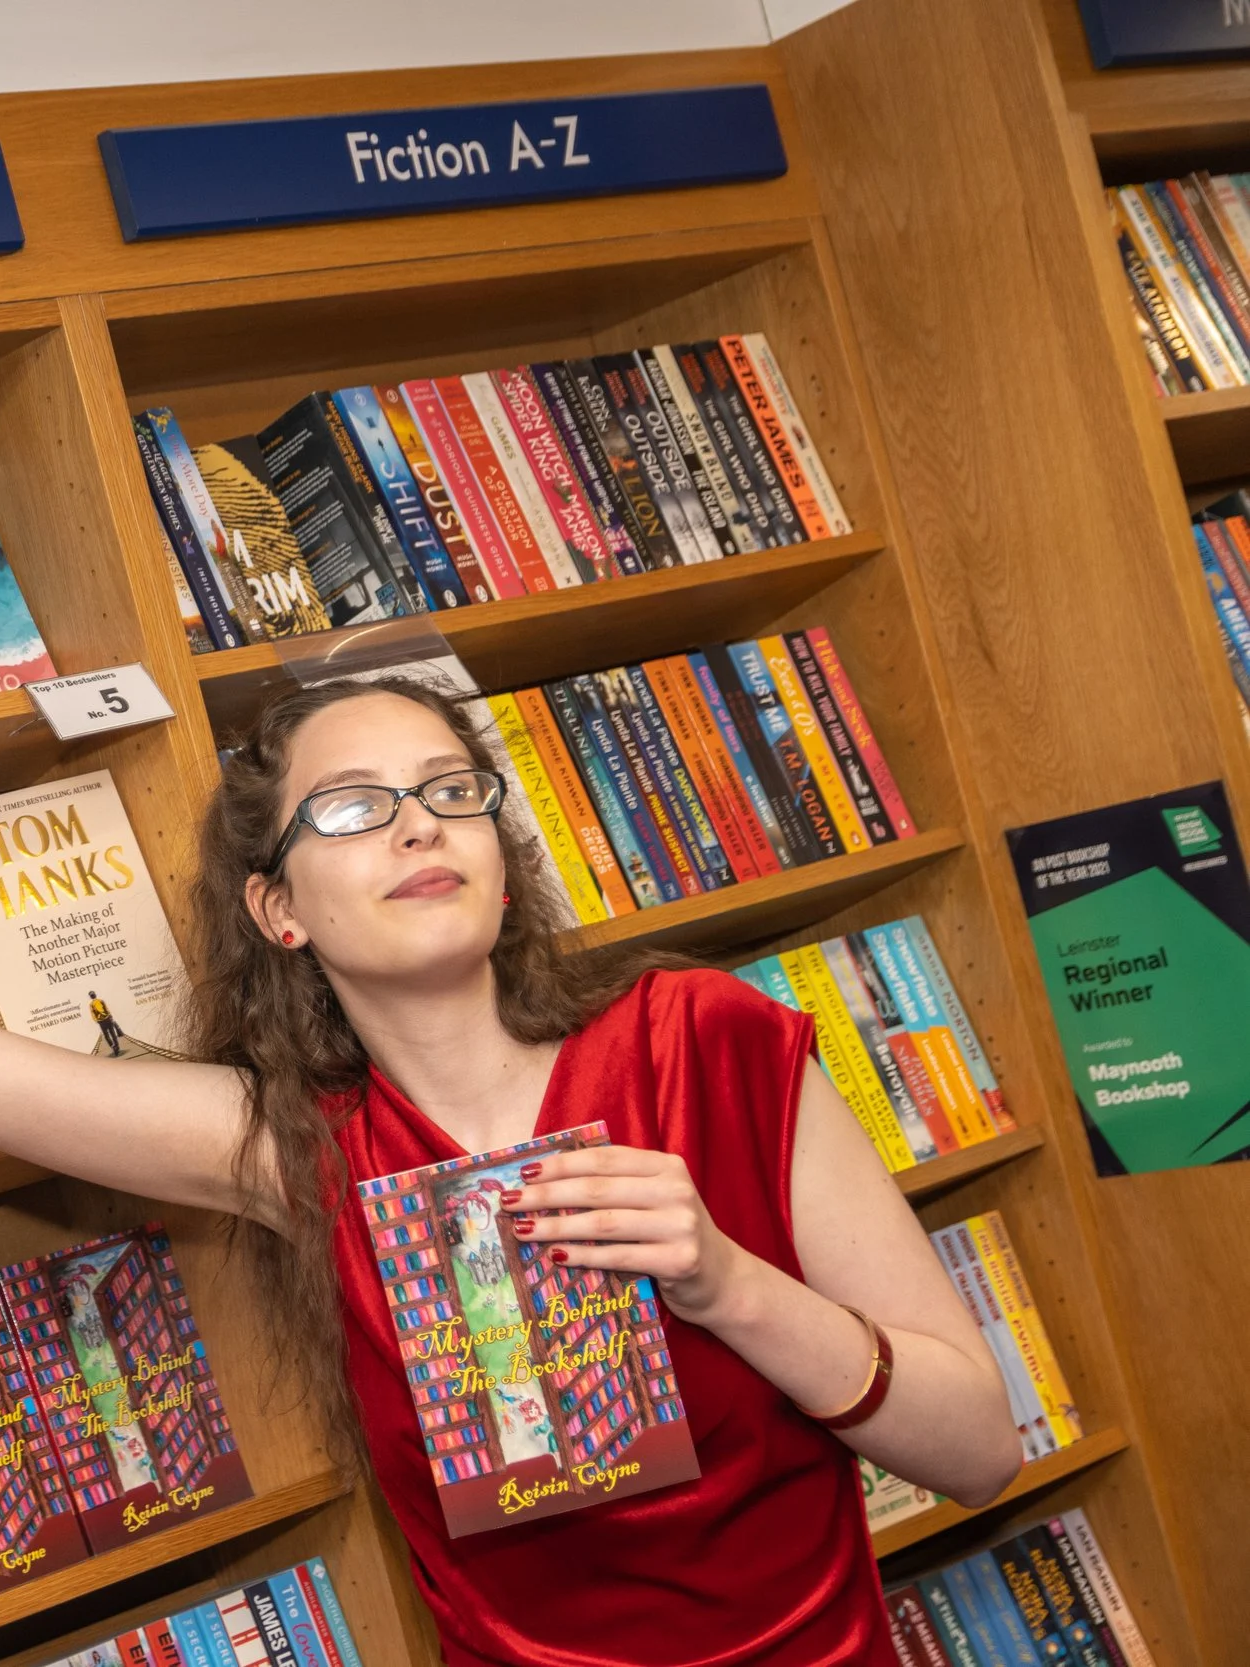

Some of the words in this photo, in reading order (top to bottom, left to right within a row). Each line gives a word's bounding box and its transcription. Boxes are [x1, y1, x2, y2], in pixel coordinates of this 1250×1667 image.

[346, 128, 490, 183] Fiction
[510, 115, 590, 171] A-Z
[502, 382, 533, 432] SPIDER
[528, 438, 556, 481] KING
[511, 373, 546, 430] MOON
[540, 431, 572, 486] WITCH
[727, 340, 767, 410] PETER
[762, 416, 805, 488] JAMES
[626, 414, 670, 494] OUTSIDE
[646, 411, 691, 491] OUTSIDE
[380, 461, 439, 549] SHIFT
[412, 461, 470, 547] DUST
[33, 685, 51, 693] Top
[67, 672, 116, 687] Bestsellers
[99, 688, 129, 713] 5
[741, 650, 777, 706] TRUST
[765, 708, 788, 734] ME
[610, 709, 631, 741] Lynda
[624, 742, 637, 758] La
[632, 756, 654, 793] Plante
[540, 797, 570, 849] KING
[797, 780, 833, 841] LOGAN
[20, 923, 48, 940] The
[51, 910, 100, 931] Making
[102, 903, 115, 917] of
[27, 933, 80, 957] Another
[83, 920, 122, 941] Major
[33, 953, 80, 973] Motion
[82, 938, 128, 957] Picture
[1057, 932, 1121, 958] Leinster
[47, 955, 125, 985] Masterpiece
[872, 932, 920, 1023] Snowflake
[892, 927, 938, 1018] Snowflake
[1063, 947, 1169, 986] Regional
[1069, 983, 1154, 1013] Winner
[942, 991, 980, 1062] NORTON
[875, 1044, 918, 1122] Betrayals
[1089, 1051, 1183, 1082] Maynooth
[1096, 1079, 1191, 1107] Bookshop
[416, 1316, 532, 1363] Mystery
[539, 1284, 637, 1329] Behind
[449, 1367, 496, 1397] The
[502, 1331, 630, 1384] Bookshelf
[572, 1461, 640, 1493] Coyne
[1057, 1537, 1075, 1567] IAN
[1071, 1567, 1104, 1624] RANKIN
